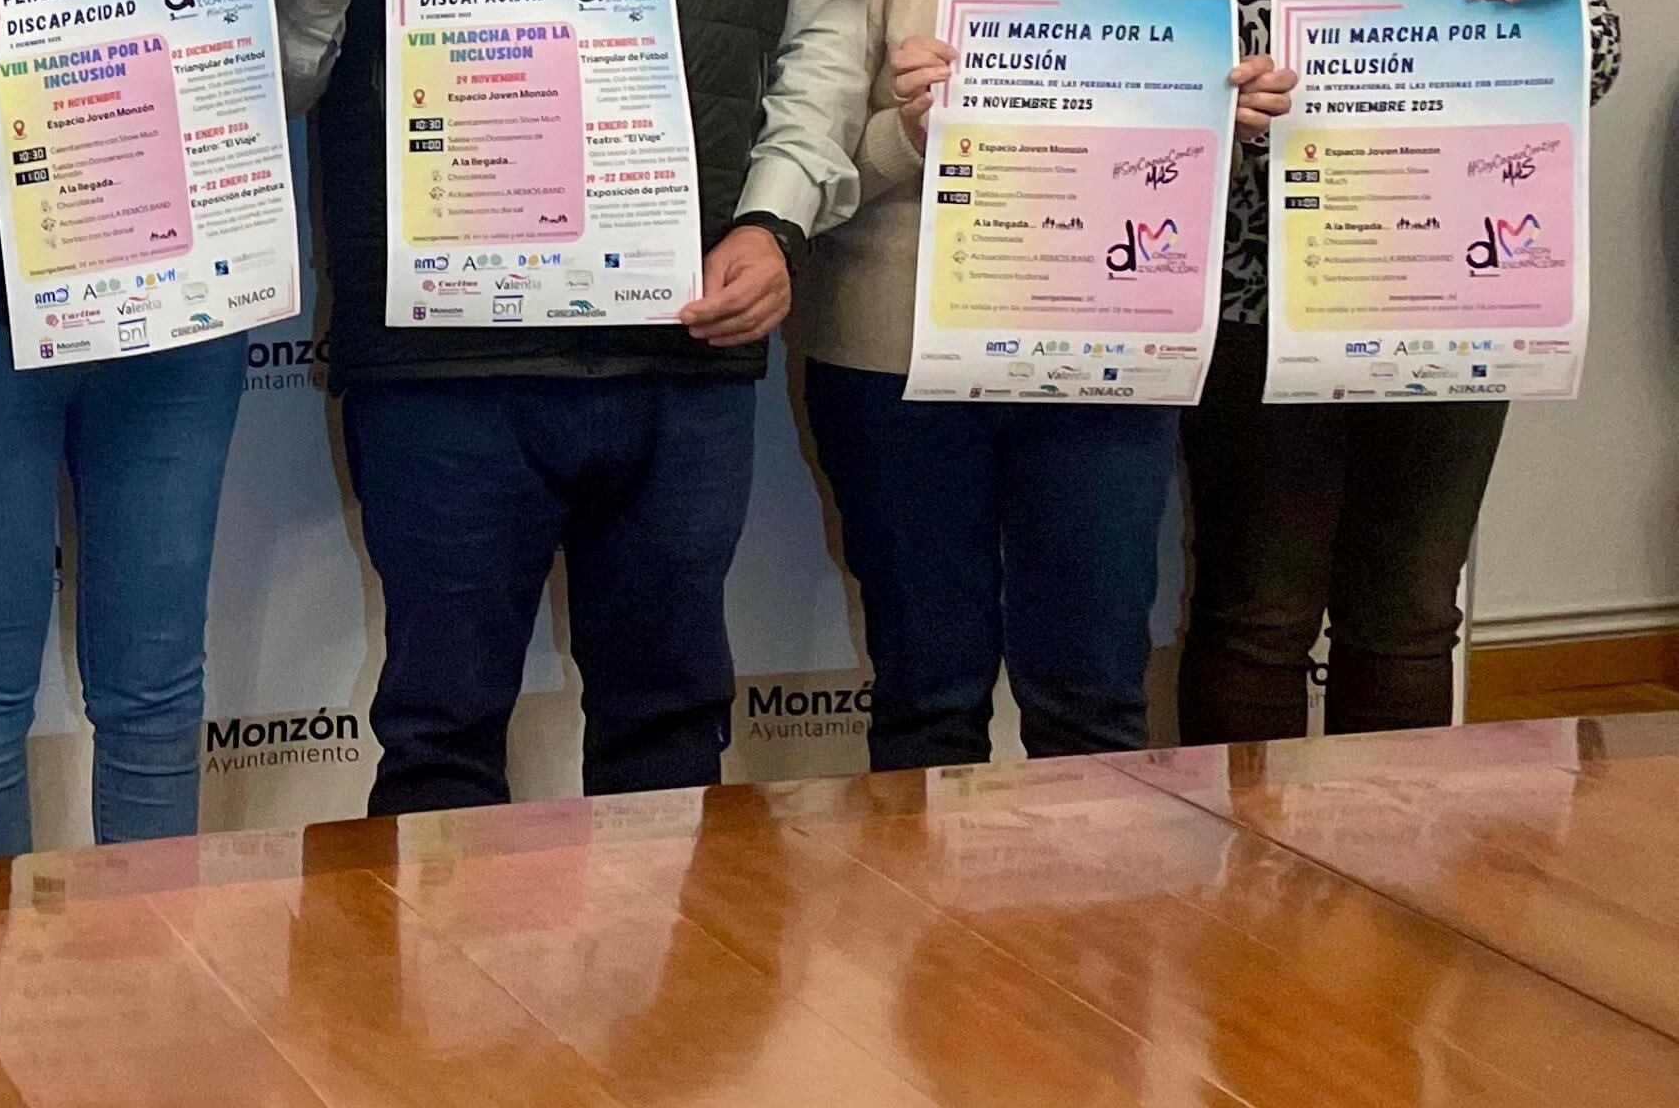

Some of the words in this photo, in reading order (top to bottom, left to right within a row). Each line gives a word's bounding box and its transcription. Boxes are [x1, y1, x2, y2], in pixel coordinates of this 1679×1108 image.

[7, 0, 136, 36] DISCAPACIDAD
[408, 33, 436, 46] VIII
[442, 29, 510, 45] MARCHA
[516, 27, 546, 41] POR
[552, 26, 570, 39] LA
[969, 21, 999, 38] VIII
[1008, 22, 1092, 40] MARCHA
[1101, 25, 1140, 41] POR
[1150, 25, 1174, 42] LA
[1306, 28, 1340, 45] VIII
[1350, 26, 1439, 43] MARCHA
[1449, 25, 1486, 40] POR
[1497, 23, 1522, 39] LA
[0, 61, 29, 77] VIII
[34, 51, 102, 72] MARCHA
[108, 41, 139, 60] POR
[144, 38, 162, 53] LA
[174, 59, 221, 75] Triangular
[223, 57, 233, 67] de
[235, 50, 265, 65] Fútbol
[580, 53, 625, 64] Triangular
[627, 53, 637, 62] de
[639, 51, 668, 60] Fútbol
[965, 49, 1067, 70] INCLUSIÓN
[1305, 53, 1414, 75] INCLUSIÓN
[448, 92, 486, 103] Espacio
[489, 91, 518, 101] Joven
[520, 88, 558, 99] Monzón
[963, 96, 978, 108] 29
[983, 97, 1057, 109] NOVIEMBRE
[1062, 98, 1093, 110] 2025
[1305, 101, 1321, 113] 29
[1327, 100, 1406, 112] NOVIEMBRE
[1411, 99, 1443, 112] 2025
[47, 114, 85, 130] Espacio
[86, 110, 115, 124] Joven
[117, 103, 155, 119] Monzón
[191, 188, 241, 209] Exposición
[241, 187, 252, 198] de
[253, 182, 284, 198] pintura
[587, 186, 639, 198] Exposición
[641, 186, 653, 195] de
[654, 184, 689, 197] pintura
[748, 681, 872, 717] Monzó
[206, 707, 359, 752] Monzón
[206, 746, 359, 774] Ayuntamiento
